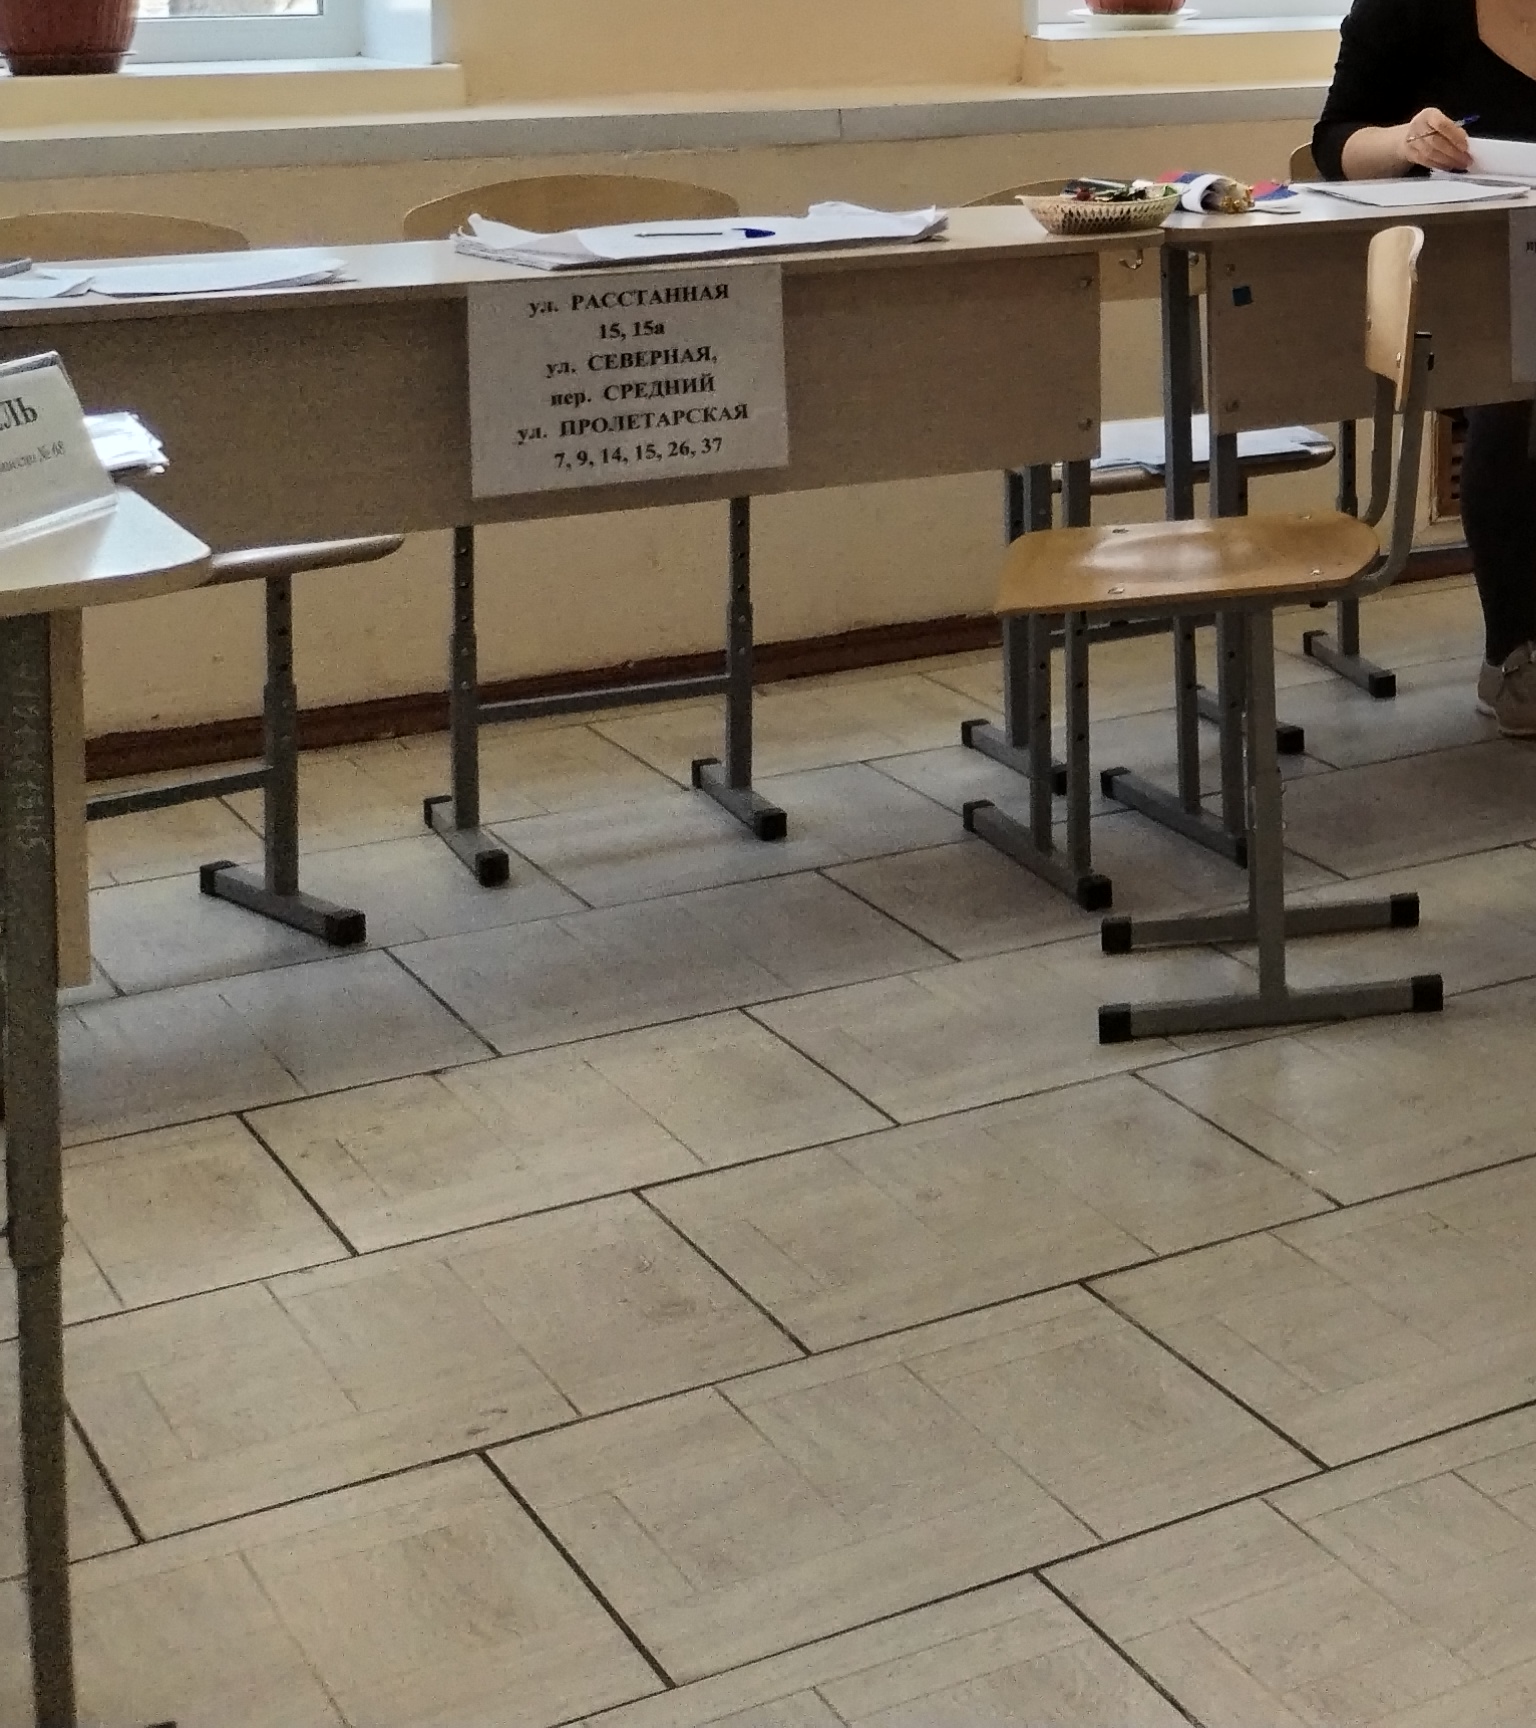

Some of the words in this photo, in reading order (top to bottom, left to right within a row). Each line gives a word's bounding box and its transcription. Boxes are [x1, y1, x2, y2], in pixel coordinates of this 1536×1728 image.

[529, 300, 559, 318] ул.
[572, 284, 729, 311] РАССТАННАЯ
[600, 323, 626, 342] 15,
[632, 321, 665, 338] 15а
[546, 362, 577, 378] ул.
[588, 346, 718, 372] СЕВЕРНАЯ,
[551, 391, 592, 408] пер.
[604, 373, 716, 401] СРЕДНИЙ
[517, 428, 547, 445] ул.
[559, 403, 749, 437] ПРОЛЕТАРСКАЯ
[555, 453, 572, 470] 7,
[577, 450, 594, 467] 9,
[601, 448, 628, 464] 14,
[635, 443, 662, 461] 15,
[668, 440, 696, 458] 26,
[702, 437, 723, 453] 37
